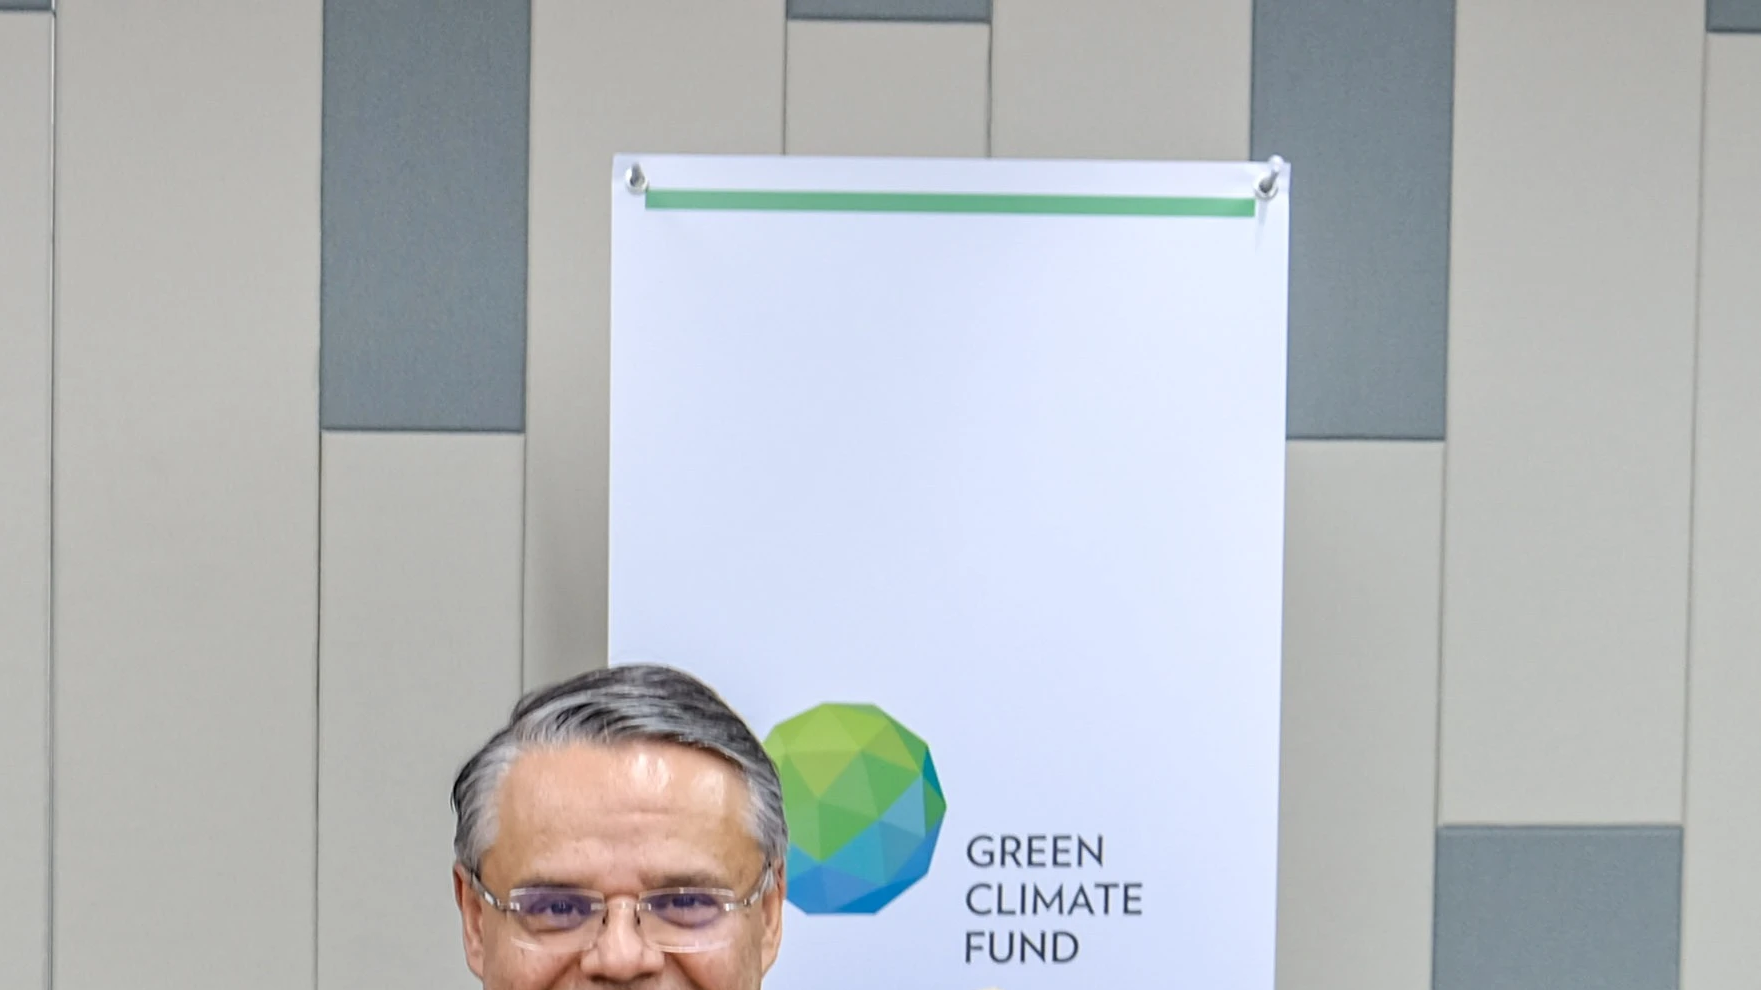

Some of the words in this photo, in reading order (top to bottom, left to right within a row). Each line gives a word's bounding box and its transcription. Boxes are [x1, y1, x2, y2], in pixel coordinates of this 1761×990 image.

[965, 834, 1105, 869] GREEN
[965, 882, 1144, 916] CLIMATE
[964, 930, 1081, 965] FUND
